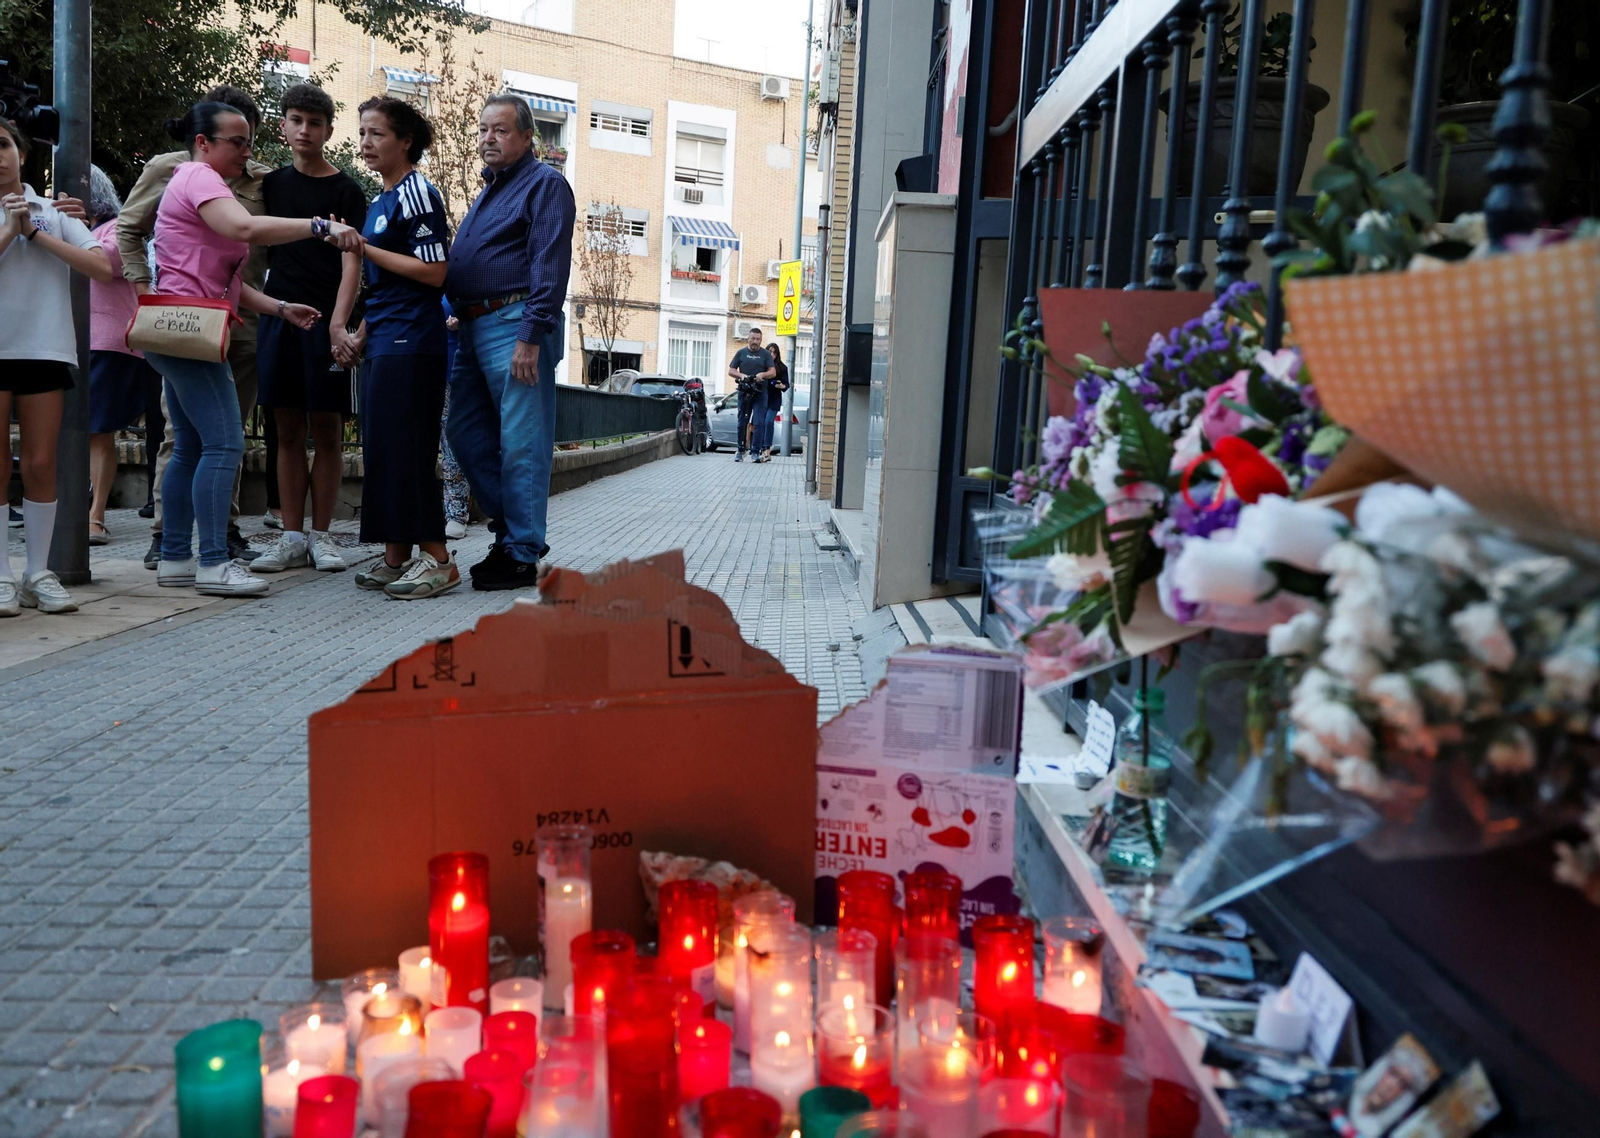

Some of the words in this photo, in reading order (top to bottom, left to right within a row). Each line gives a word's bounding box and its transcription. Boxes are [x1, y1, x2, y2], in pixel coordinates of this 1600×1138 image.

[162, 310, 173, 318] La
[168, 319, 201, 333] Bella
[536, 808, 610, 827] V14284
[854, 822, 868, 834] SIN
[818, 855, 865, 871] LECHE
